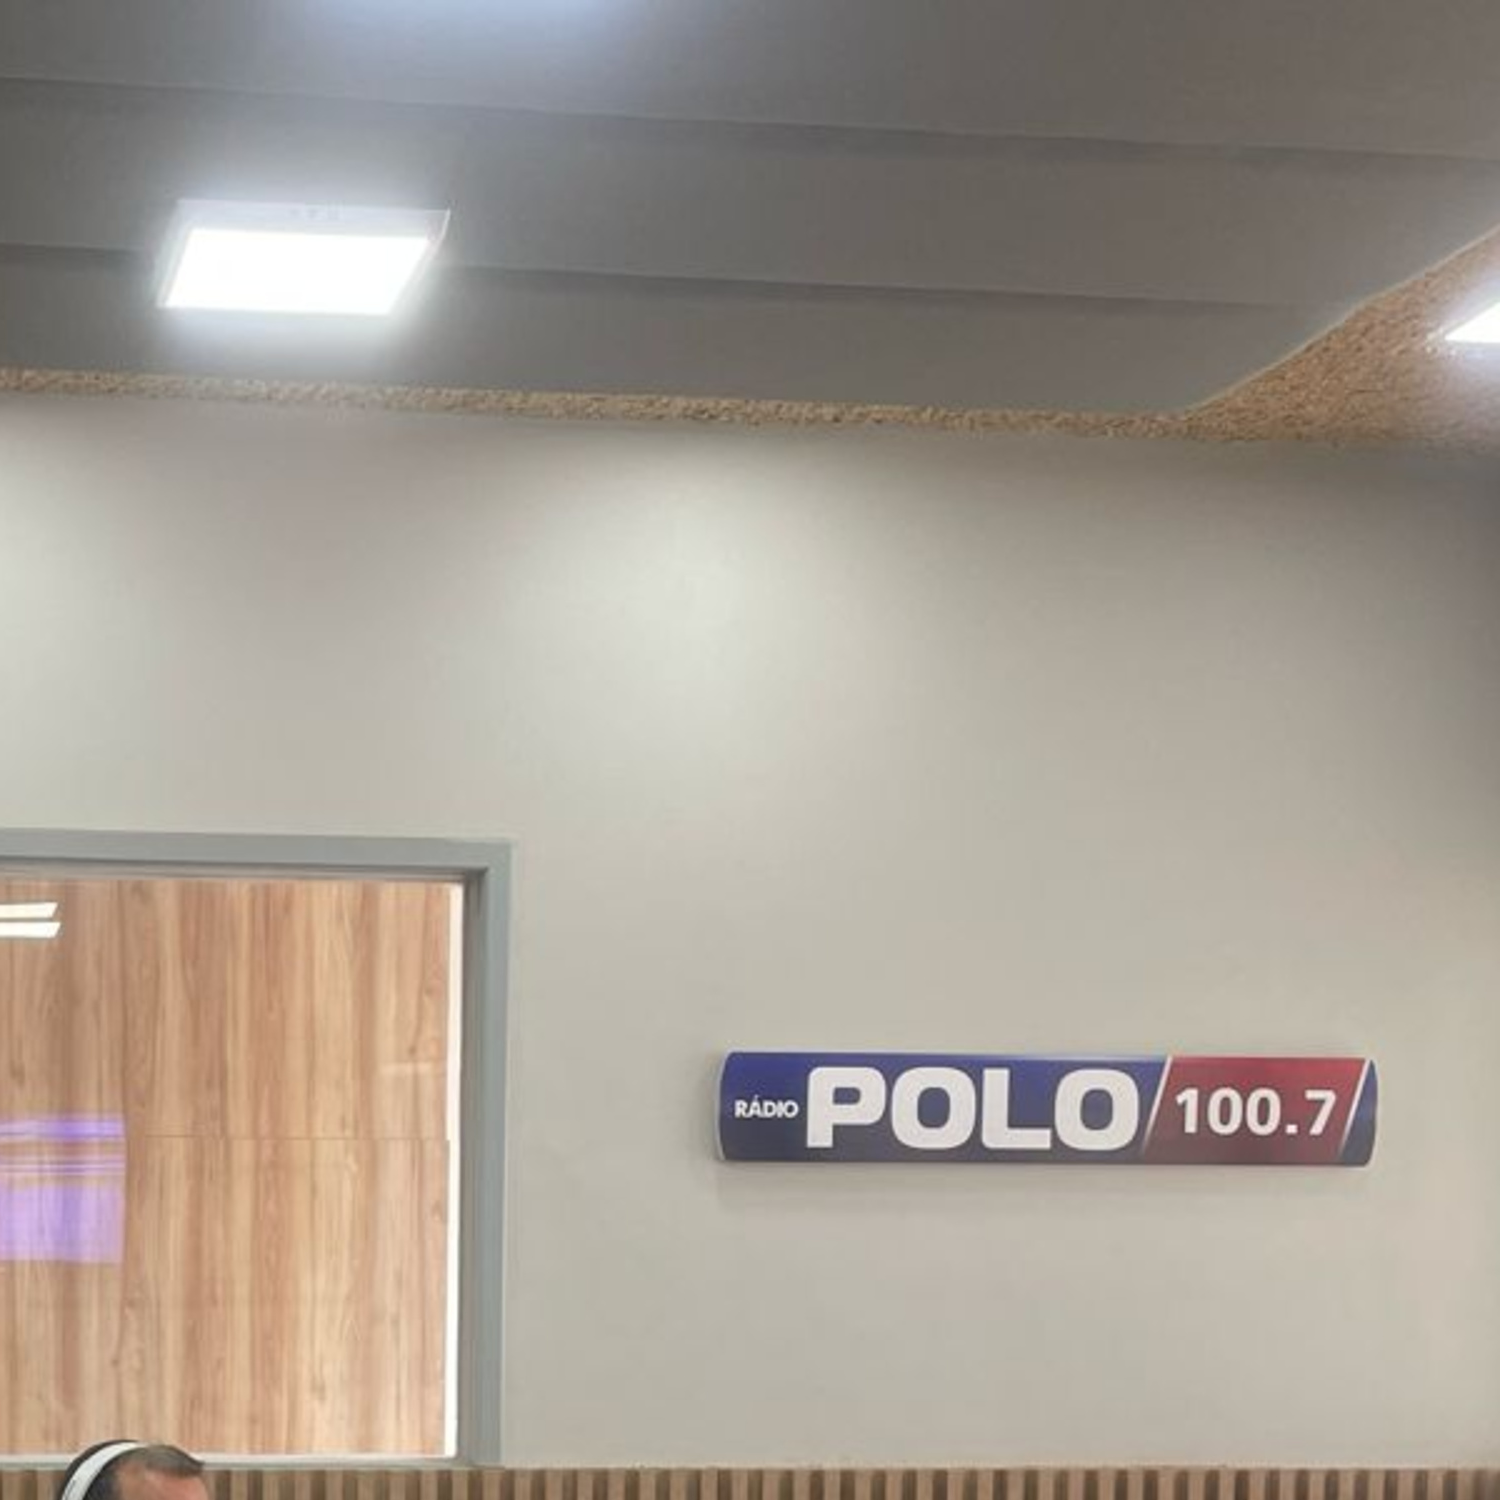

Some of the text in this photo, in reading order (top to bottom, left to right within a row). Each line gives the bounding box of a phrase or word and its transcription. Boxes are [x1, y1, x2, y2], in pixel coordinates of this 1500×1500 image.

[734, 1066, 1338, 1150] RÁDIO POLO 100.7
